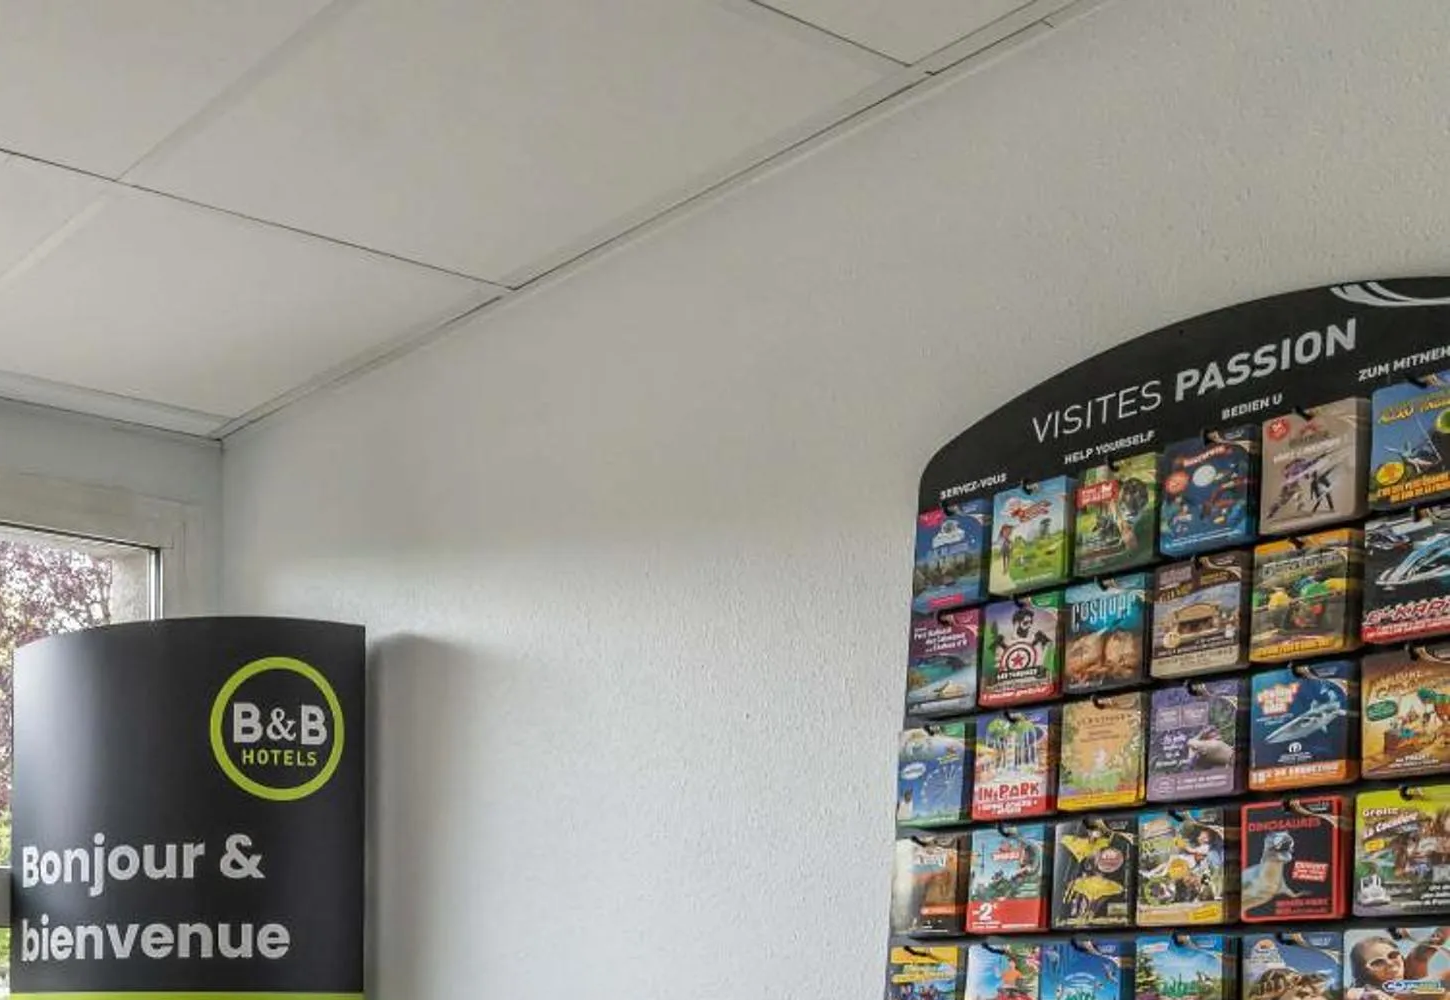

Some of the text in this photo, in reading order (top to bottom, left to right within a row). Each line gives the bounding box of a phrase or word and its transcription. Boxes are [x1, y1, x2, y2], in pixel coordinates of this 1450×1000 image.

[1032, 318, 1358, 443] VISITES PASSION
[1358, 363, 1390, 382] ZUM
[1221, 392, 1283, 421] BEDIEN U
[1065, 431, 1156, 465] HELP YOURSELF
[940, 472, 1007, 499] SERVEZ-VOUS
[233, 702, 328, 746] B&B
[242, 749, 318, 767] HOTELS
[22, 833, 266, 898] Bonjour &
[21, 914, 291, 962] bienvenue
